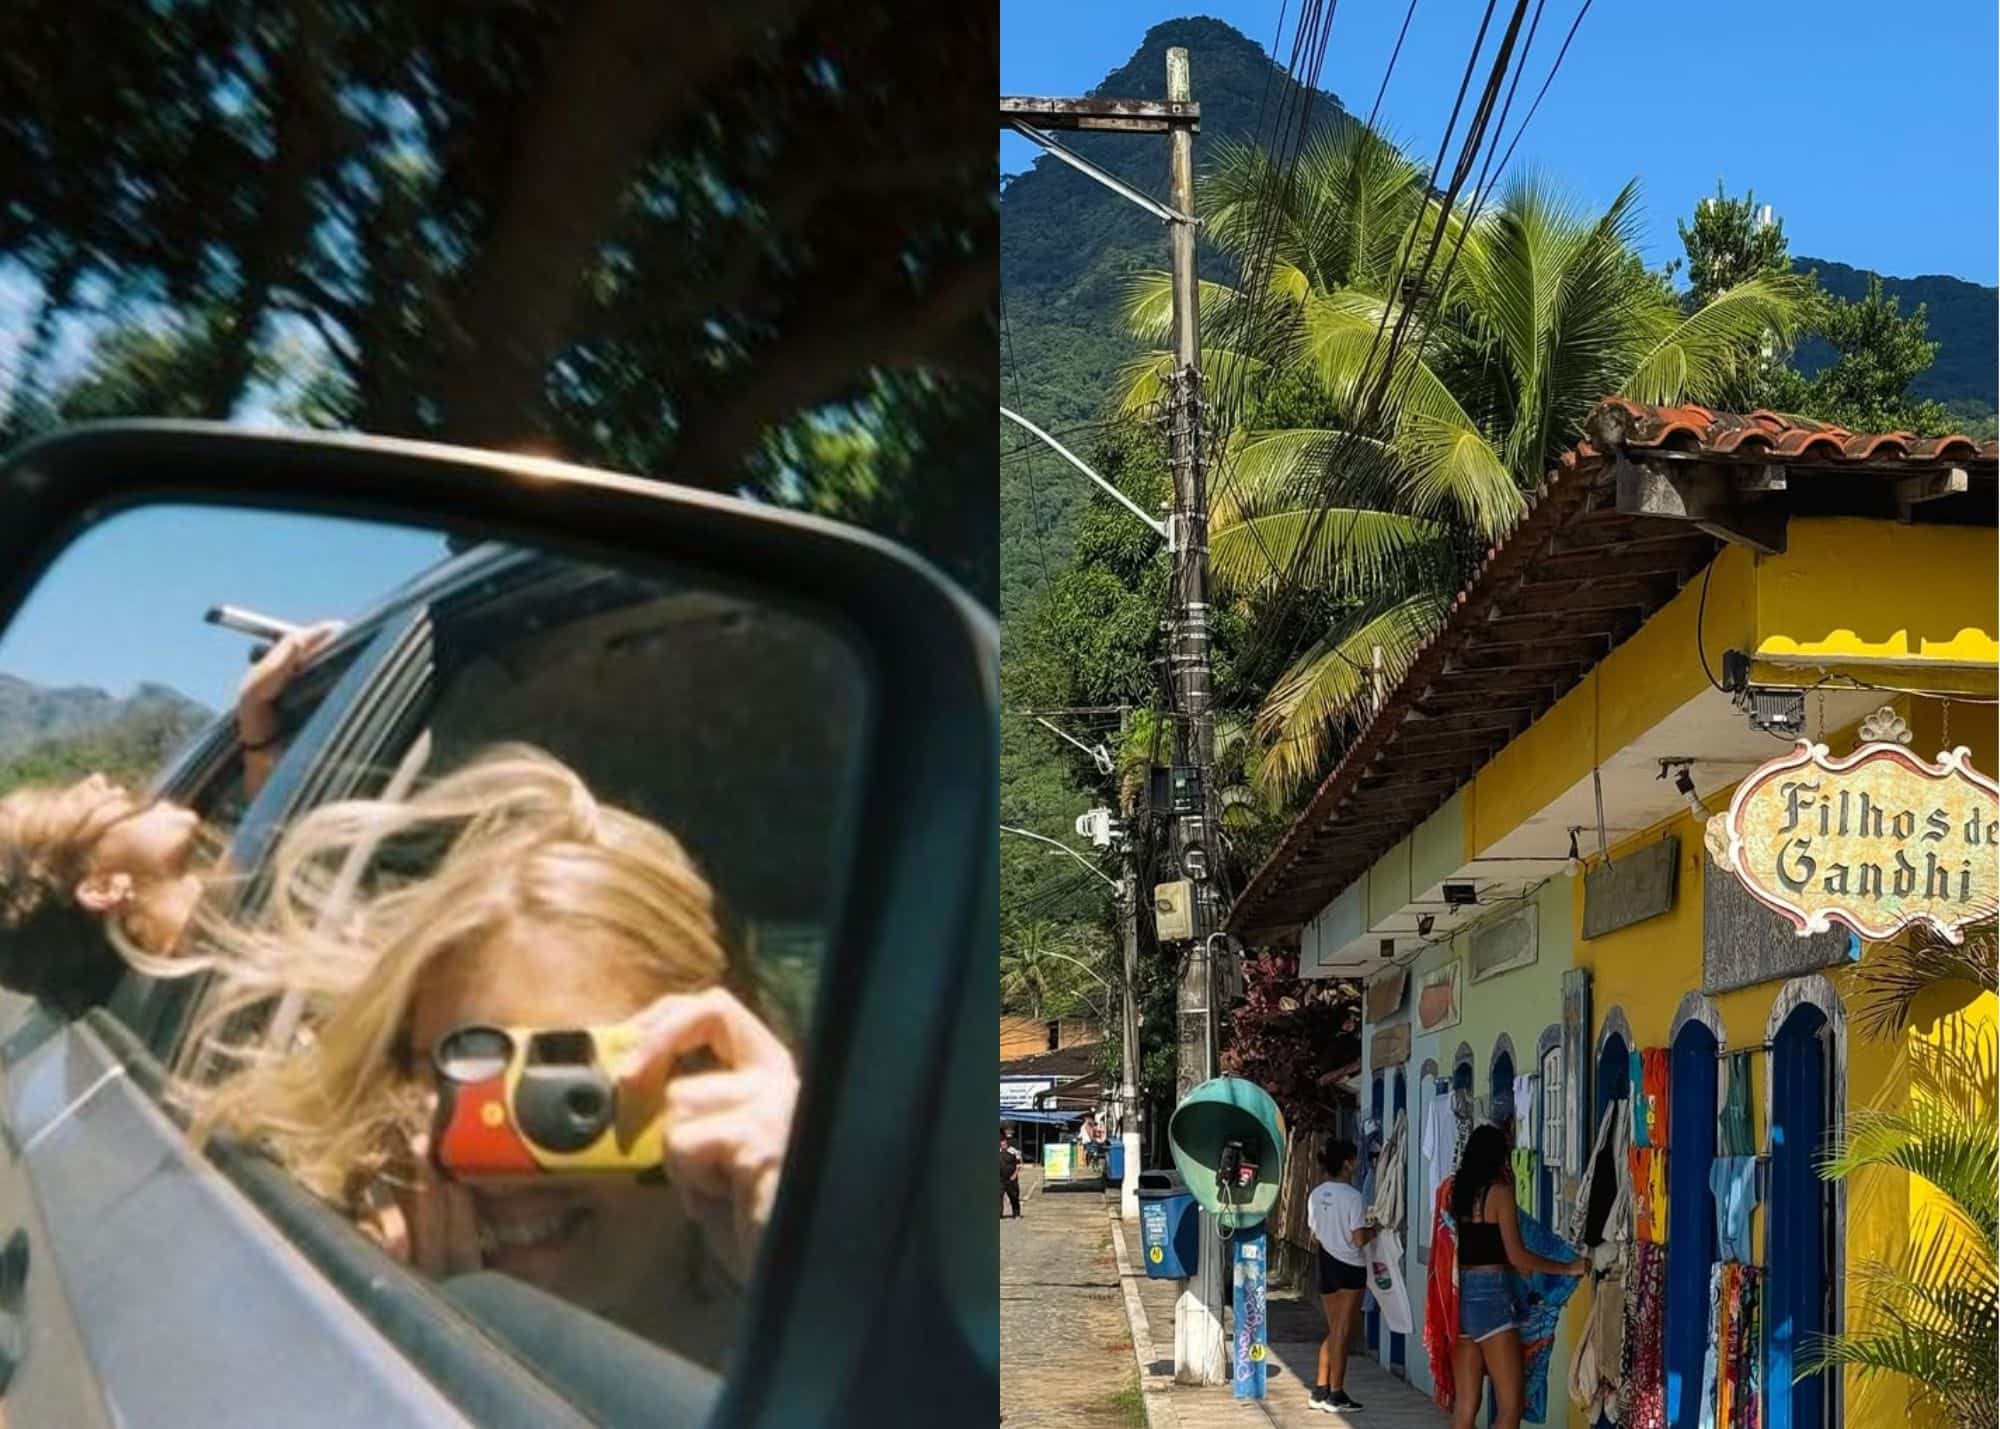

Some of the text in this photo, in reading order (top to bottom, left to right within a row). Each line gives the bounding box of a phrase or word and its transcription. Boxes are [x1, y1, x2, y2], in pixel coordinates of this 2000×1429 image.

[1778, 780, 1998, 847] Filhos de
[1776, 836, 1973, 903] Gandhi
